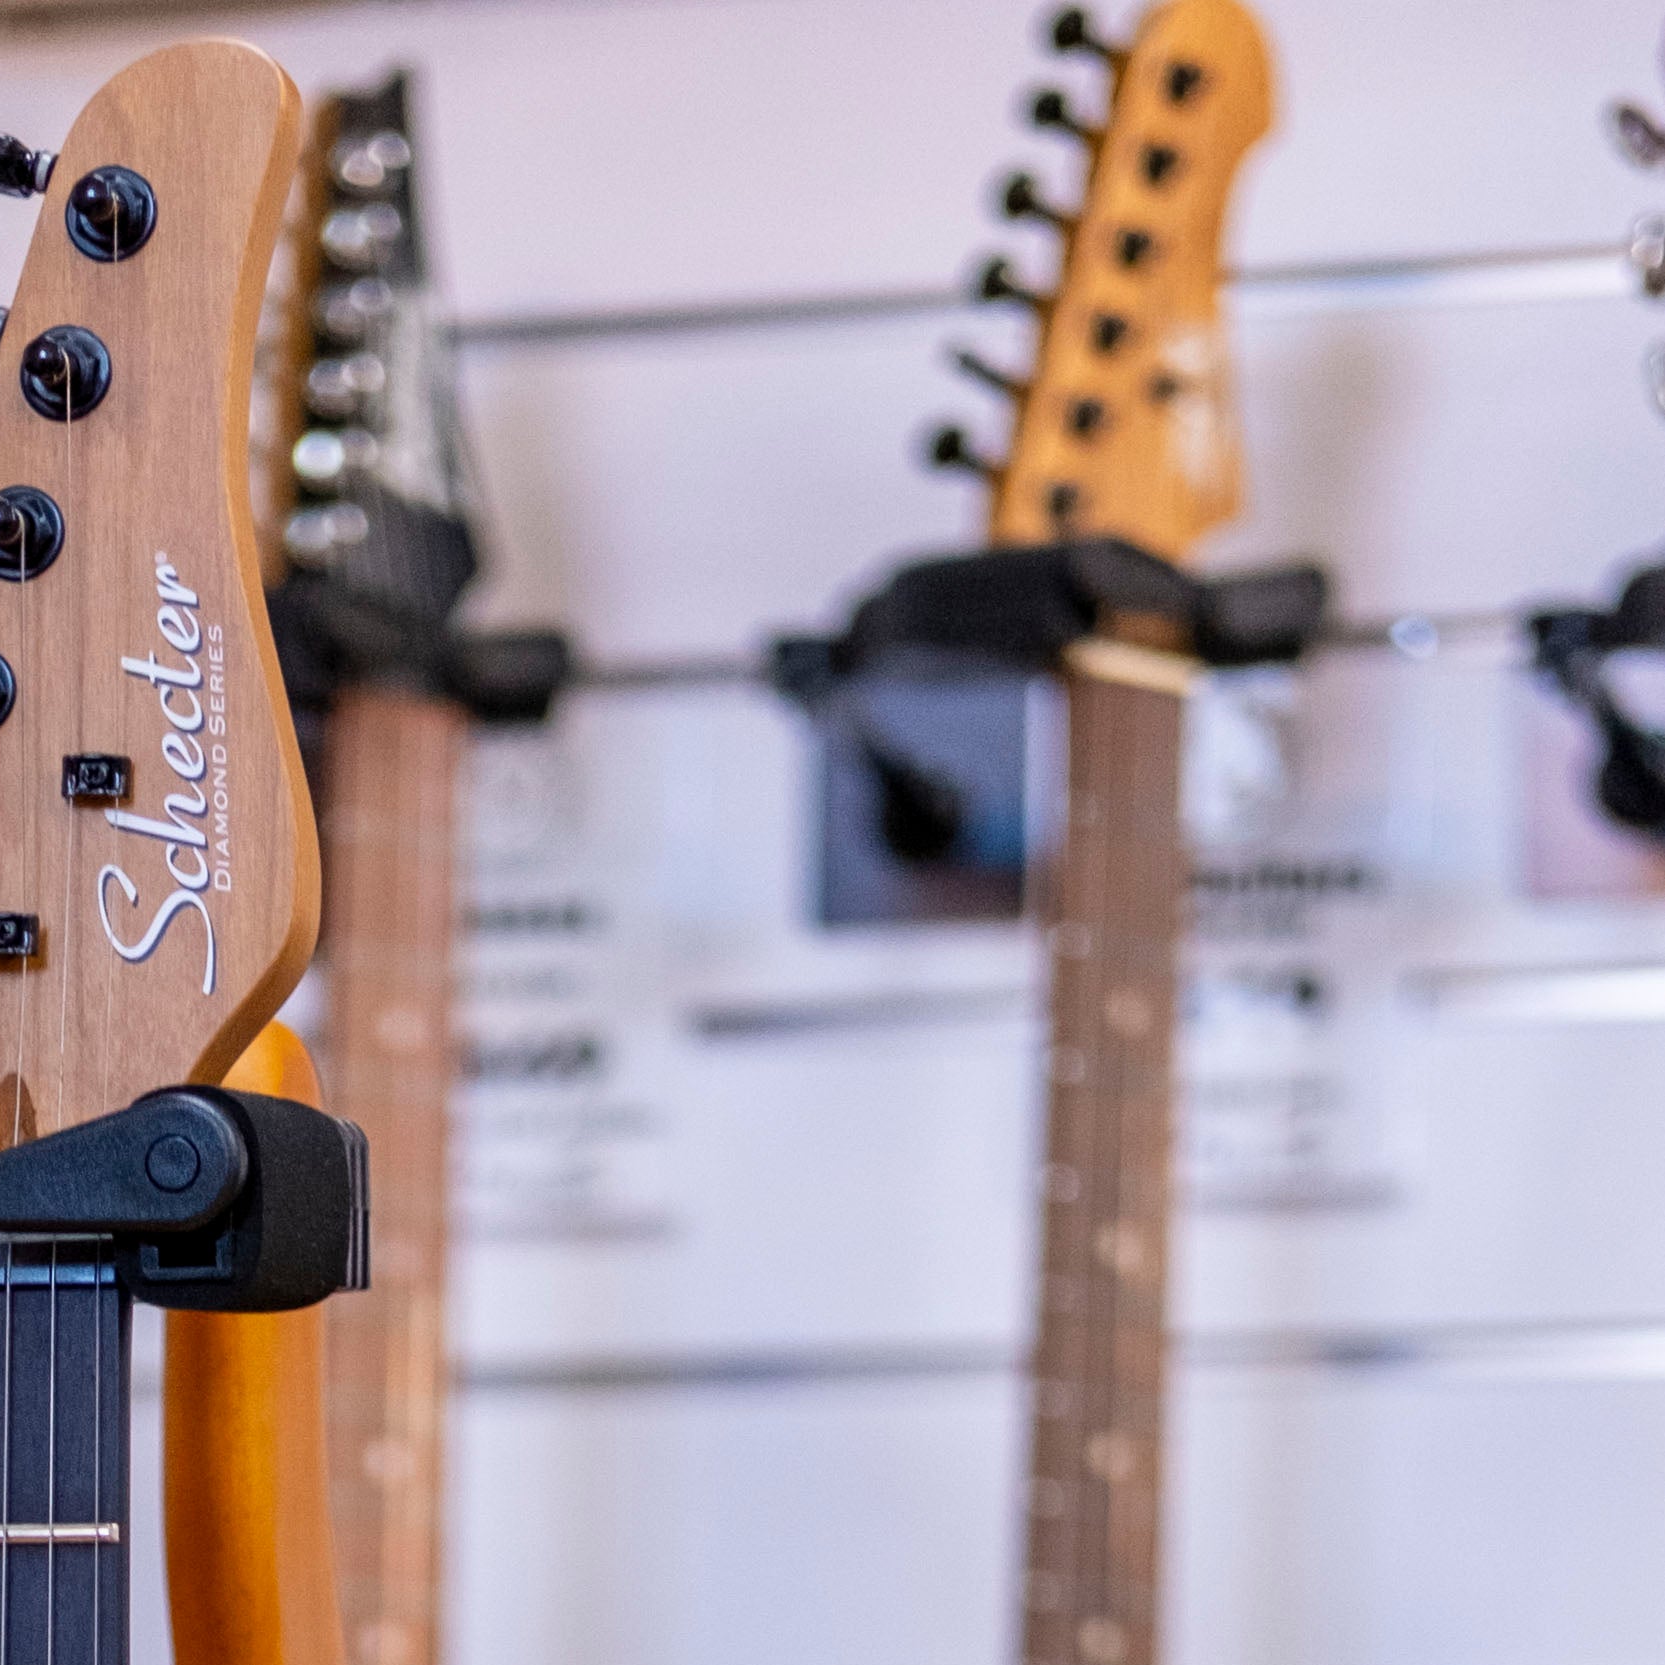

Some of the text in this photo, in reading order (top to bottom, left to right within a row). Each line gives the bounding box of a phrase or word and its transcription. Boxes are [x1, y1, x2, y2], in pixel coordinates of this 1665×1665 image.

[97, 560, 216, 996] Schecter
[208, 624, 232, 893] DIAMOND SERIES
